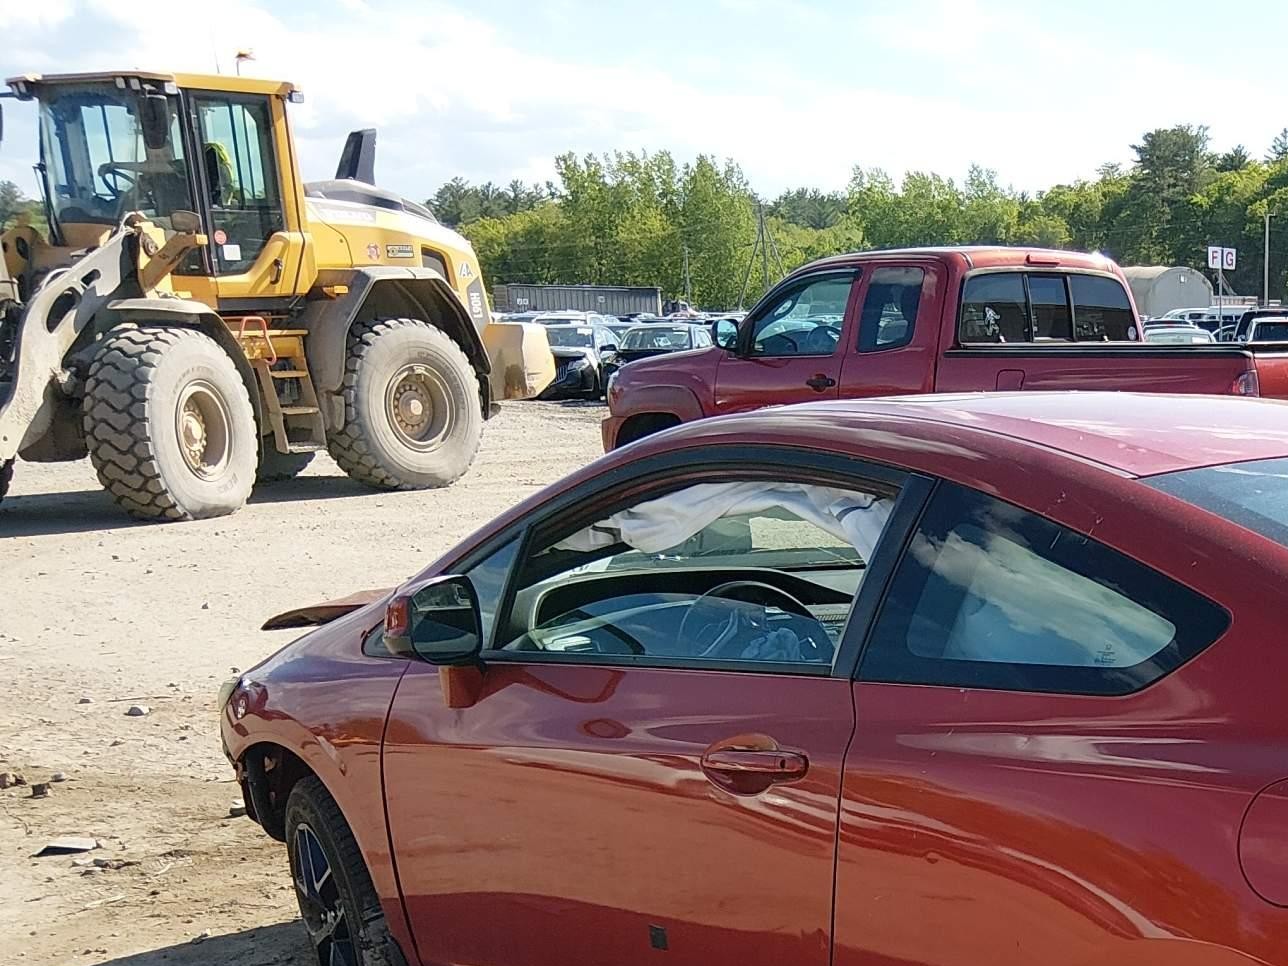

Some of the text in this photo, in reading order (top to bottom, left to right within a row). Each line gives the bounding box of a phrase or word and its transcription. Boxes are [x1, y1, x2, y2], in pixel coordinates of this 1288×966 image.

[1211, 250, 1219, 265] F
[1225, 251, 1234, 267] G
[469, 292, 484, 319] L90H
